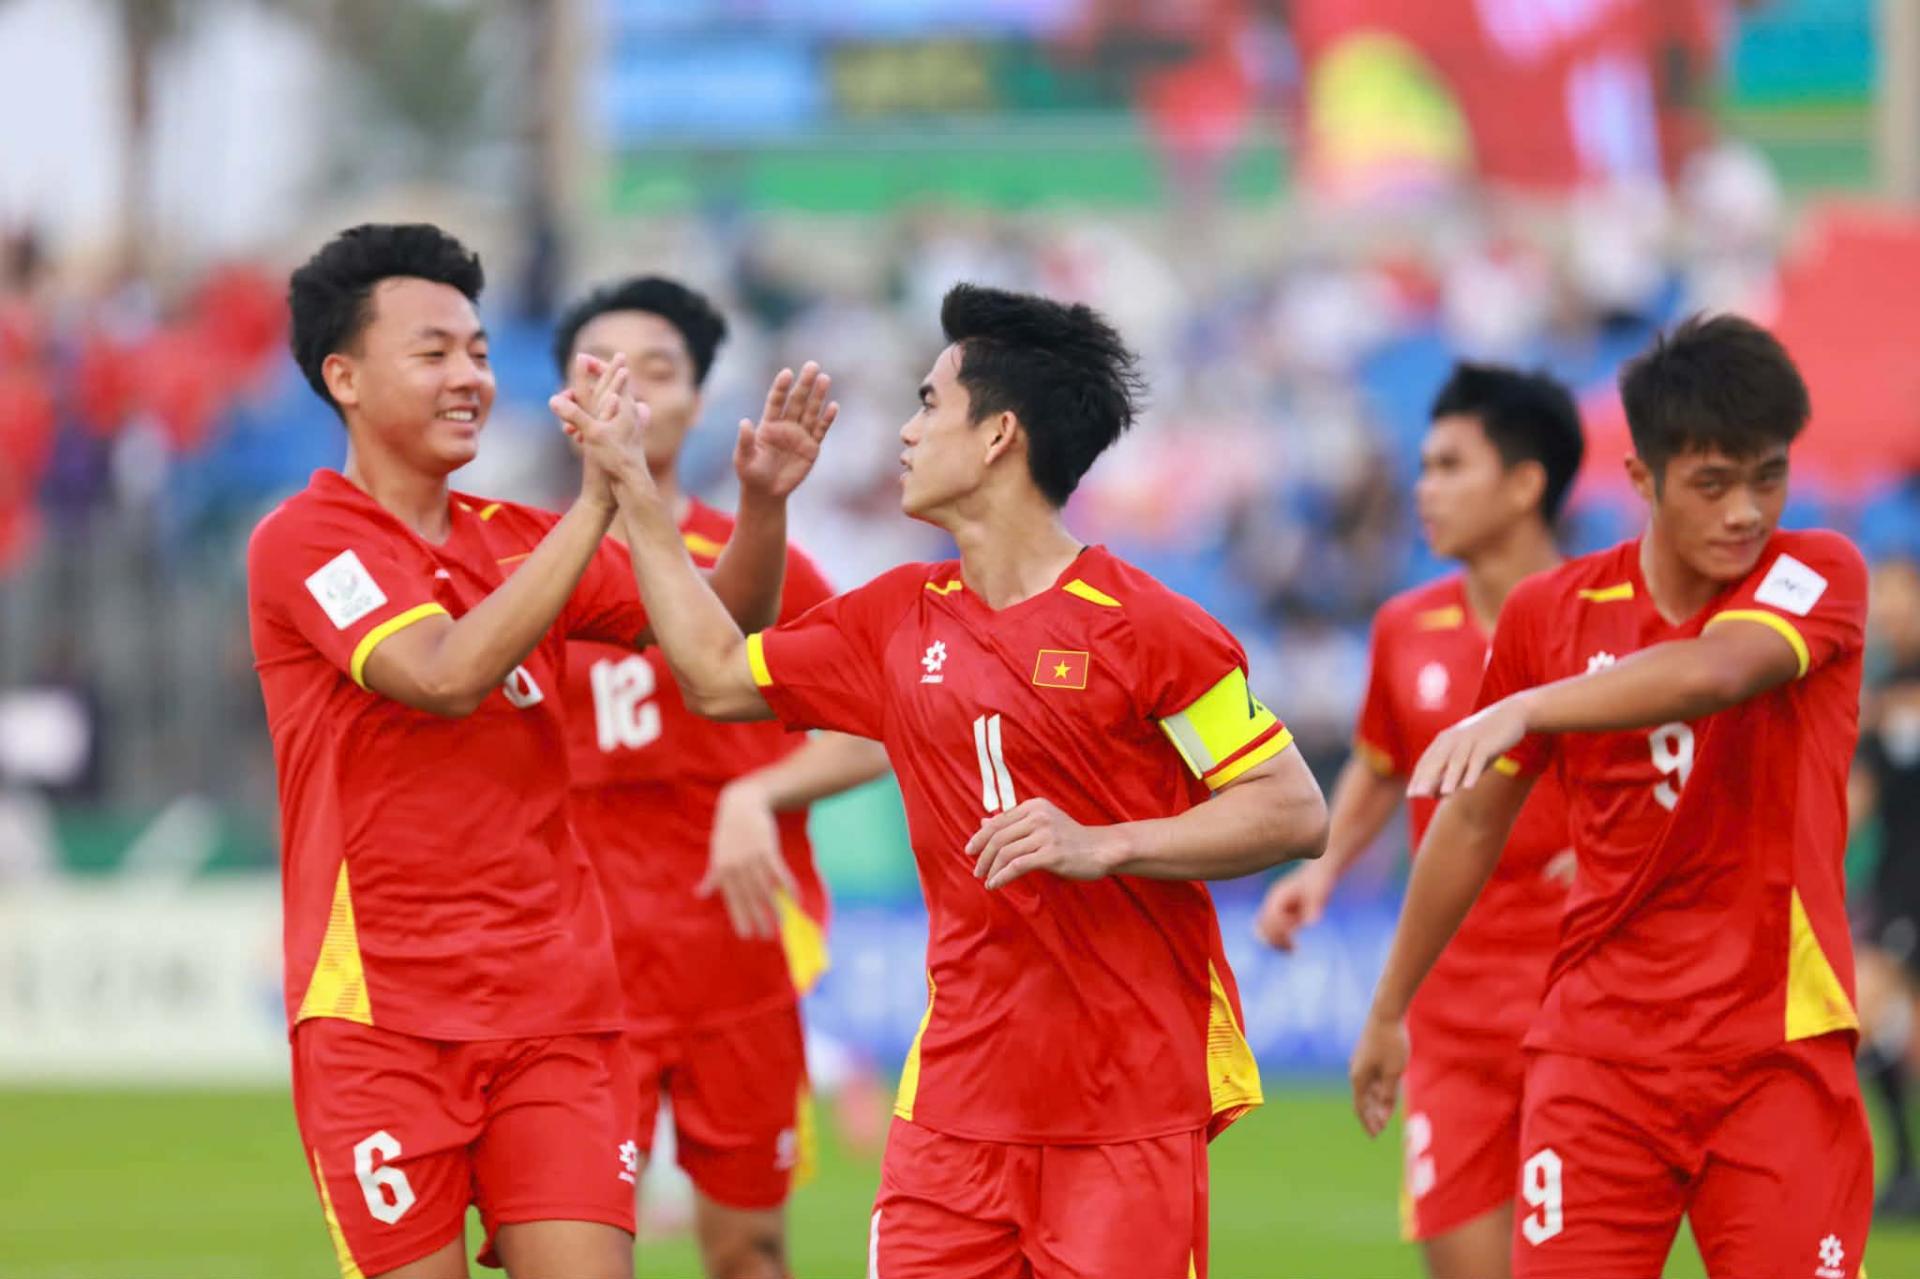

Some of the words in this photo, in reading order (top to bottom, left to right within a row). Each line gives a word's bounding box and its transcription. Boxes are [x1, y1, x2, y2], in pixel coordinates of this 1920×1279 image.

[590, 654, 661, 753] 12
[974, 713, 1017, 813] 11
[1650, 722, 1695, 811] 9
[353, 1130, 416, 1225] 6
[1523, 1148, 1563, 1246] 9
